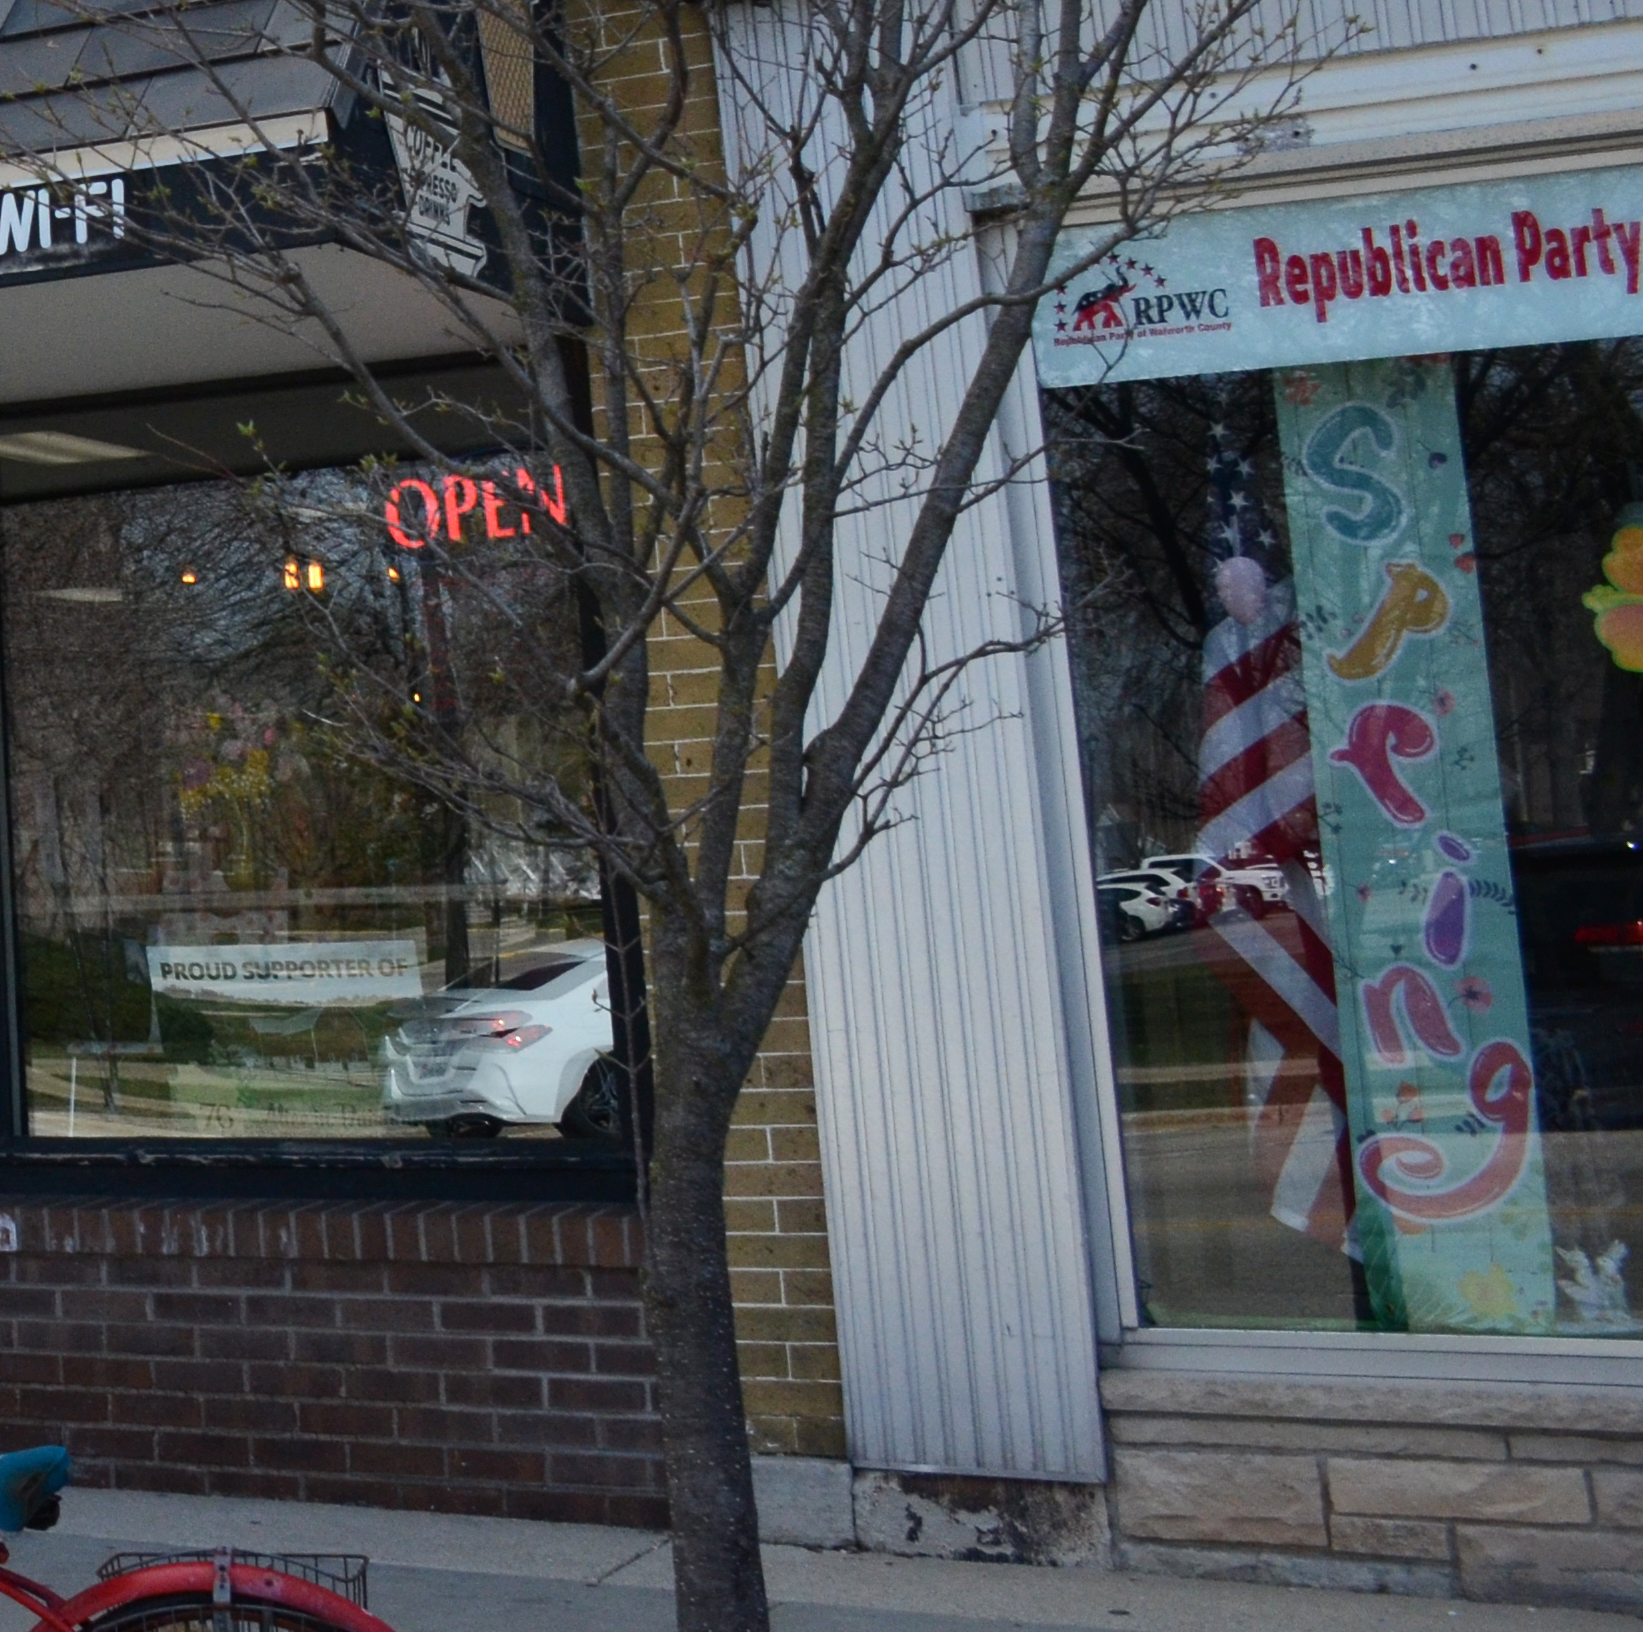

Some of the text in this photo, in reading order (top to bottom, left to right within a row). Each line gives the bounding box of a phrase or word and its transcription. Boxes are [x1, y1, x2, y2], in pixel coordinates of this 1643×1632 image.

[1253, 207, 1642, 323] Republican Party
[1129, 287, 1231, 326] RPWC
[1053, 333, 1107, 348] Republican
[1137, 329, 1148, 338] of
[1149, 325, 1196, 337] Walworth
[1197, 321, 1232, 333] County
[385, 463, 567, 550] OPEN
[158, 956, 409, 981] PROUD SUPPORTER OF
